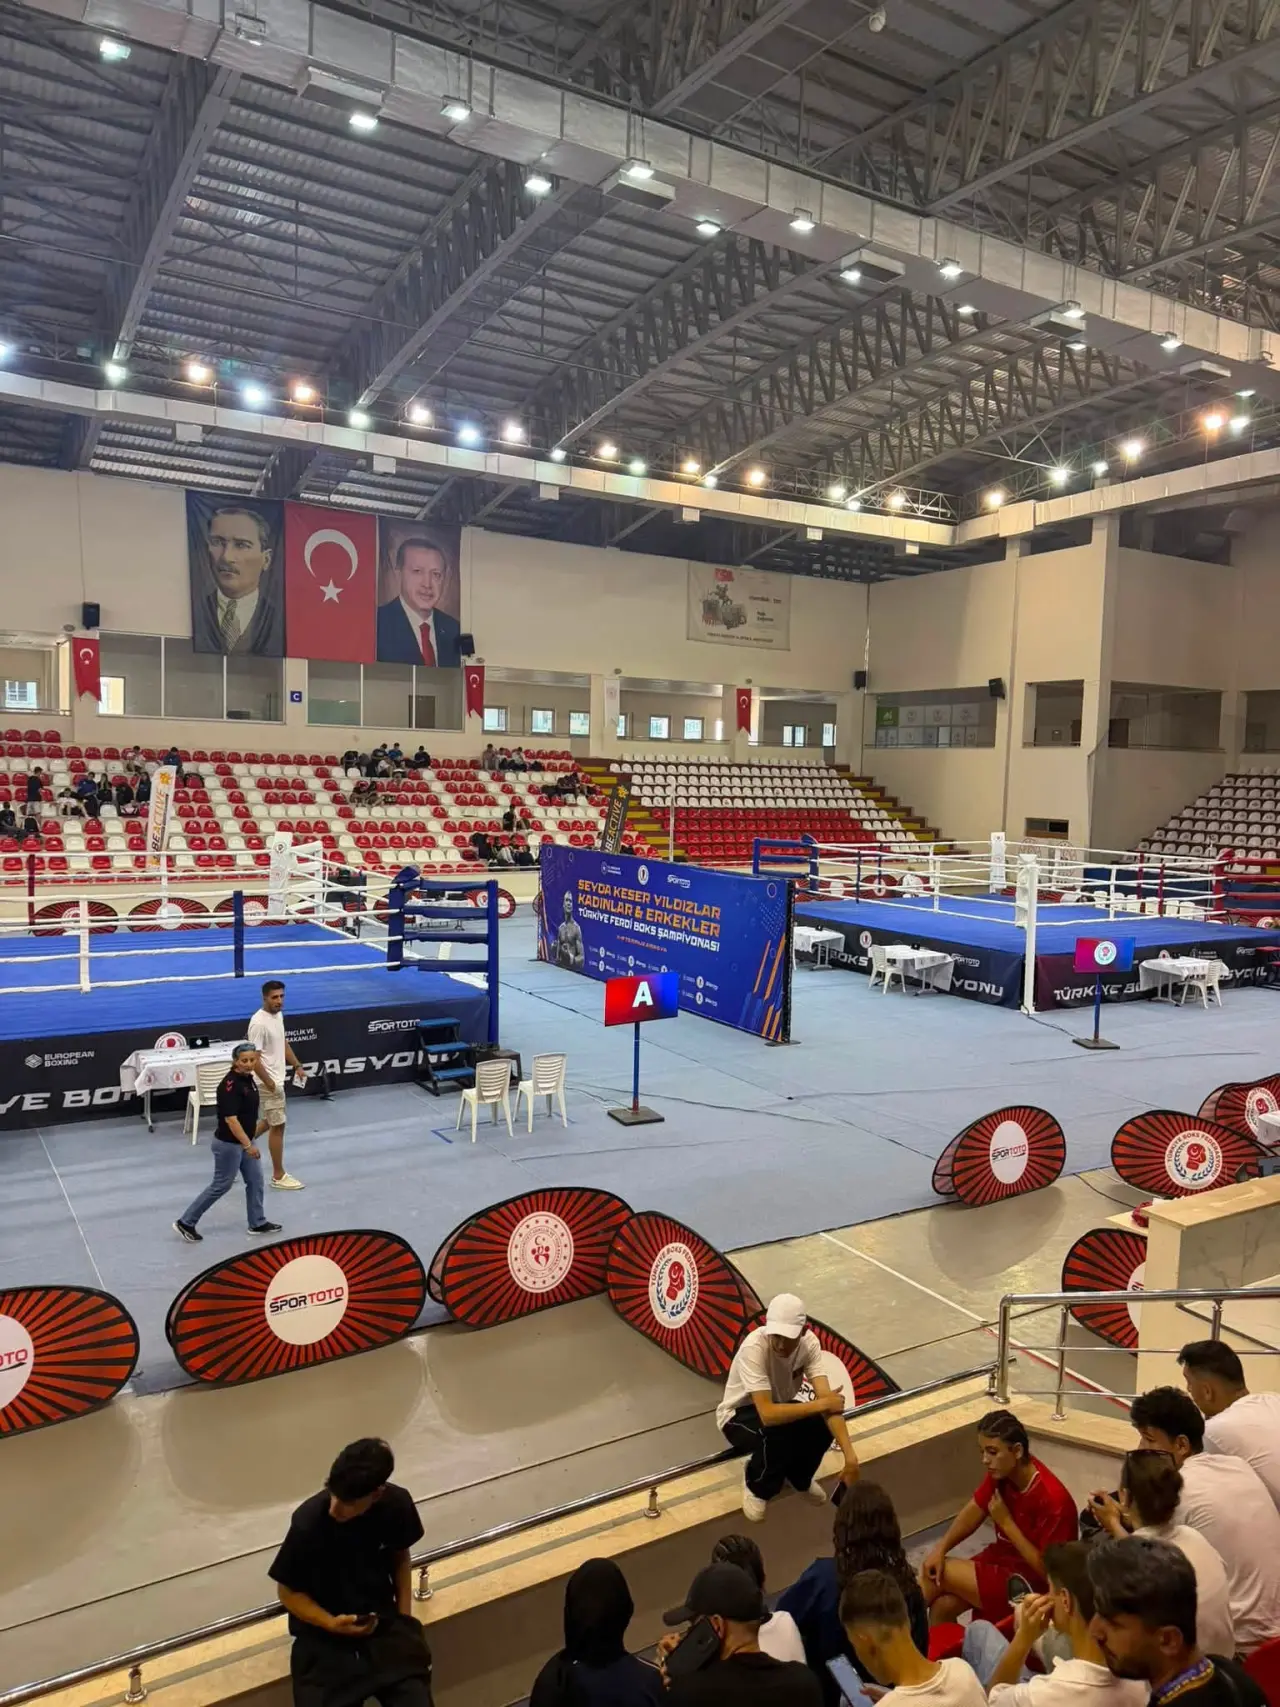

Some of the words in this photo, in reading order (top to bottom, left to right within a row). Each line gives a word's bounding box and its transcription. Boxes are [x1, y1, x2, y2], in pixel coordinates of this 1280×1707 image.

[293, 693, 300, 701] C
[151, 789, 166, 852] BEACTIVE
[605, 798, 622, 852] BEACTIVE
[578, 879, 611, 895] SEYDA
[613, 886, 650, 903] KESER
[654, 894, 721, 920] YILDIZLAR
[578, 893, 633, 916] KADINLAR
[635, 909, 643, 919] &
[646, 908, 720, 937] ERKEKLER
[578, 907, 609, 923] TÜRKİYE
[610, 916, 633, 929] FERDİ
[633, 921, 657, 936] BOKS
[657, 927, 720, 952] ŞAMPİYONASI
[632, 981, 654, 1008] A
[1053, 984, 1122, 1001] TÜRKYE
[285, 1029, 306, 1037] ENÇLİK
[44, 1051, 95, 1061] EUROPEAN
[44, 1058, 79, 1068] BOXING
[991, 1144, 1028, 1161] SPORTOTO
[269, 1286, 344, 1313] SPORTOTO
